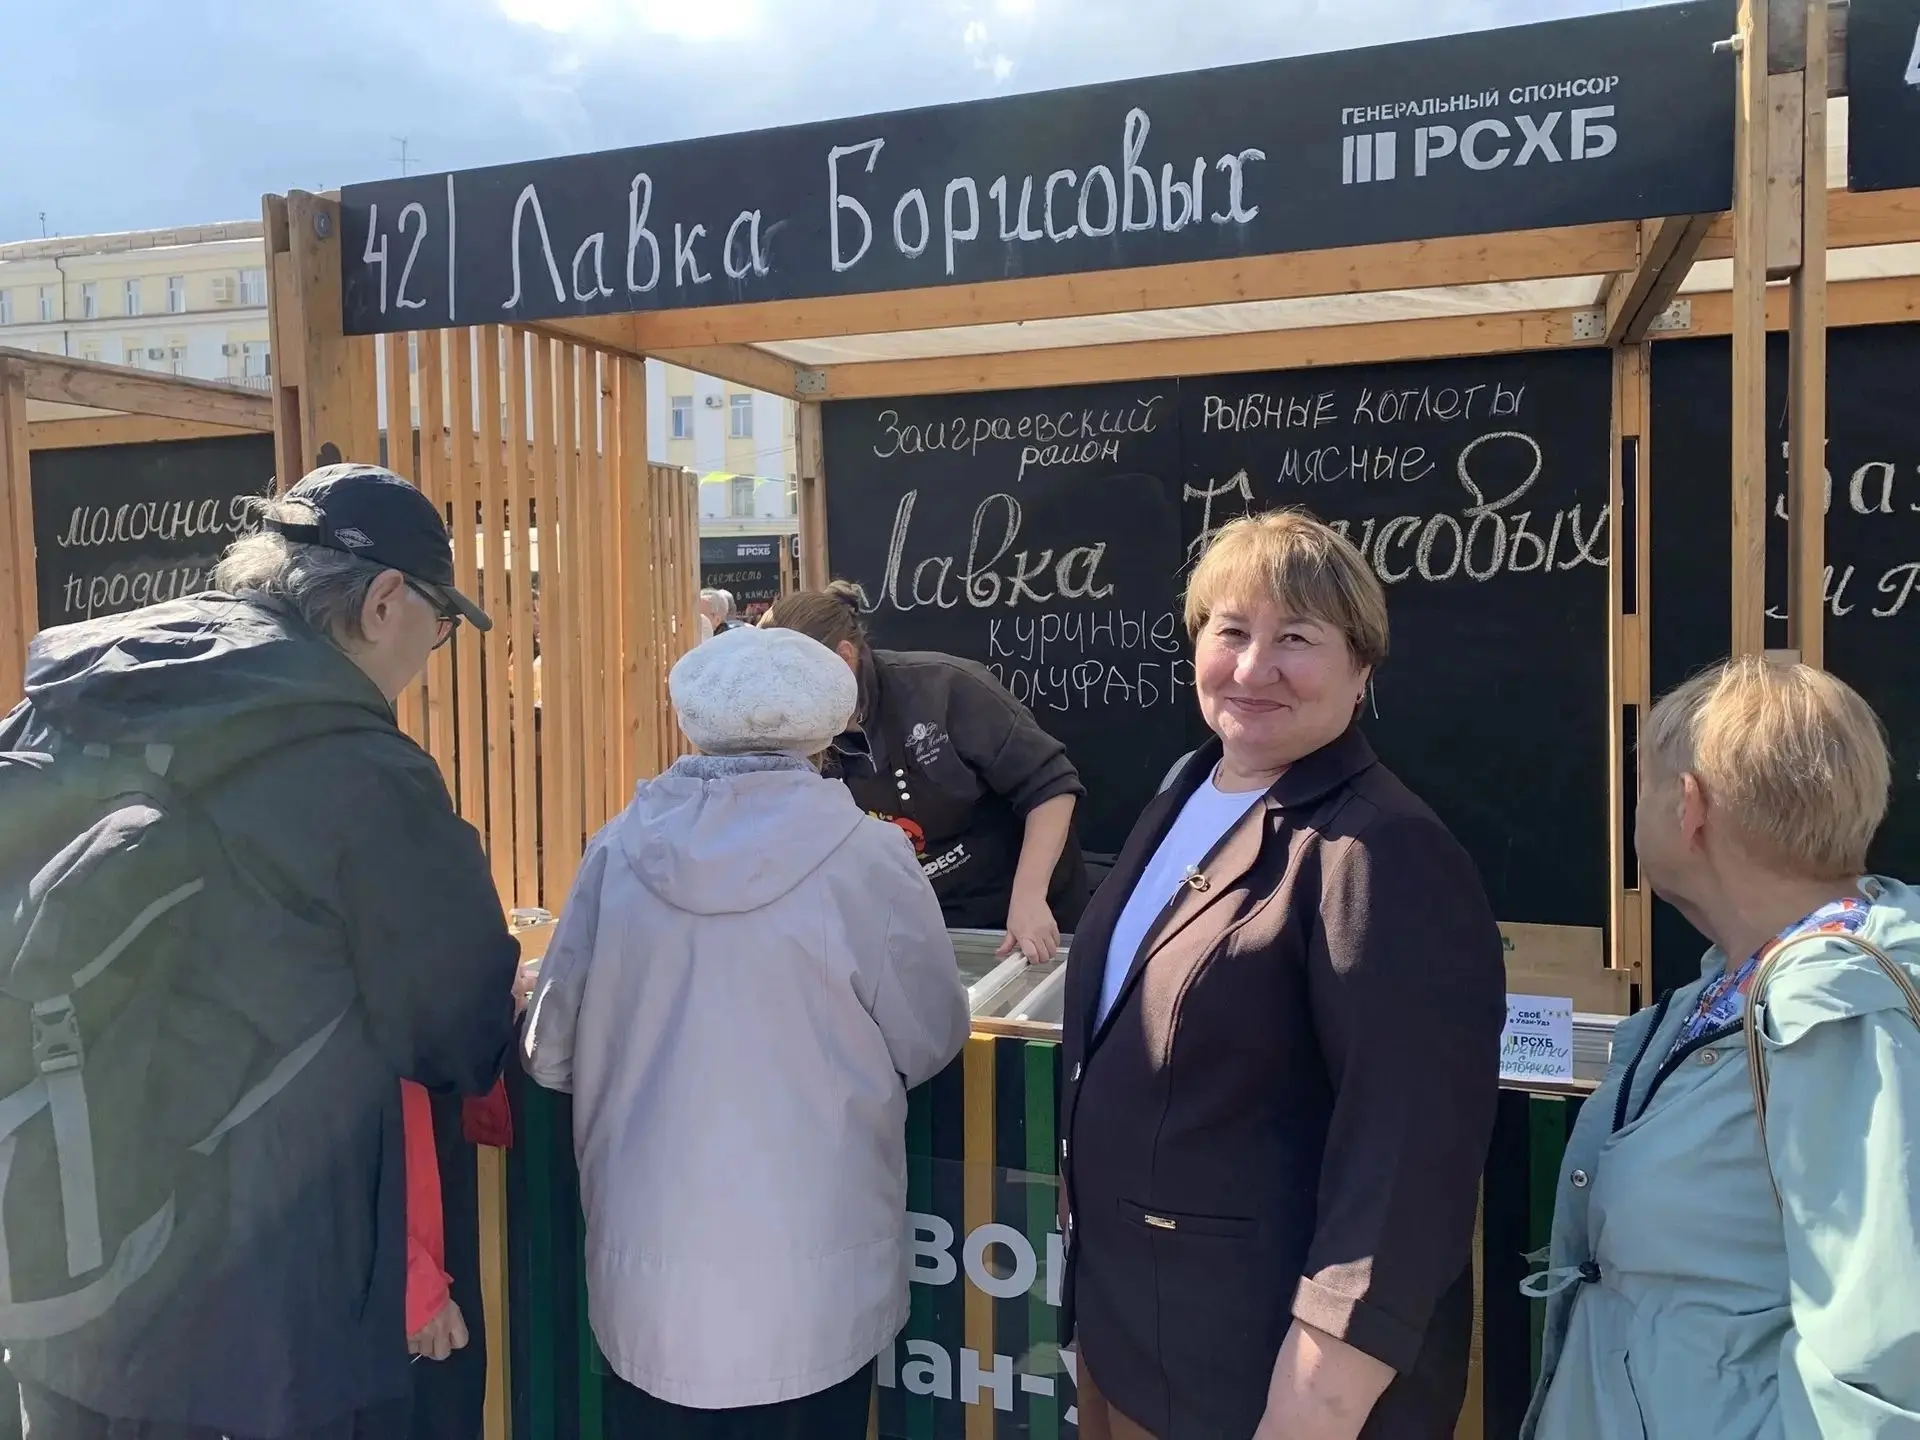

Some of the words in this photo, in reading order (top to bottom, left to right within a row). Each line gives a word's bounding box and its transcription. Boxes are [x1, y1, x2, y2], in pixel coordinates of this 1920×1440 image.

[1341, 87, 1500, 125] ГЕНЕРАЛЬНЫЙ
[1508, 75, 1620, 105] СПОНСОР
[1414, 104, 1618, 178] РСХБ
[362, 203, 428, 314] 42
[501, 172, 770, 308] Лавка
[827, 106, 1267, 275] Борисовых
[873, 395, 1164, 458] Заиграевский
[1201, 391, 1338, 433] РЫБНЫЕ
[857, 488, 1116, 614] Лавка
[1521, 1036, 1553, 1048] РСХБ
